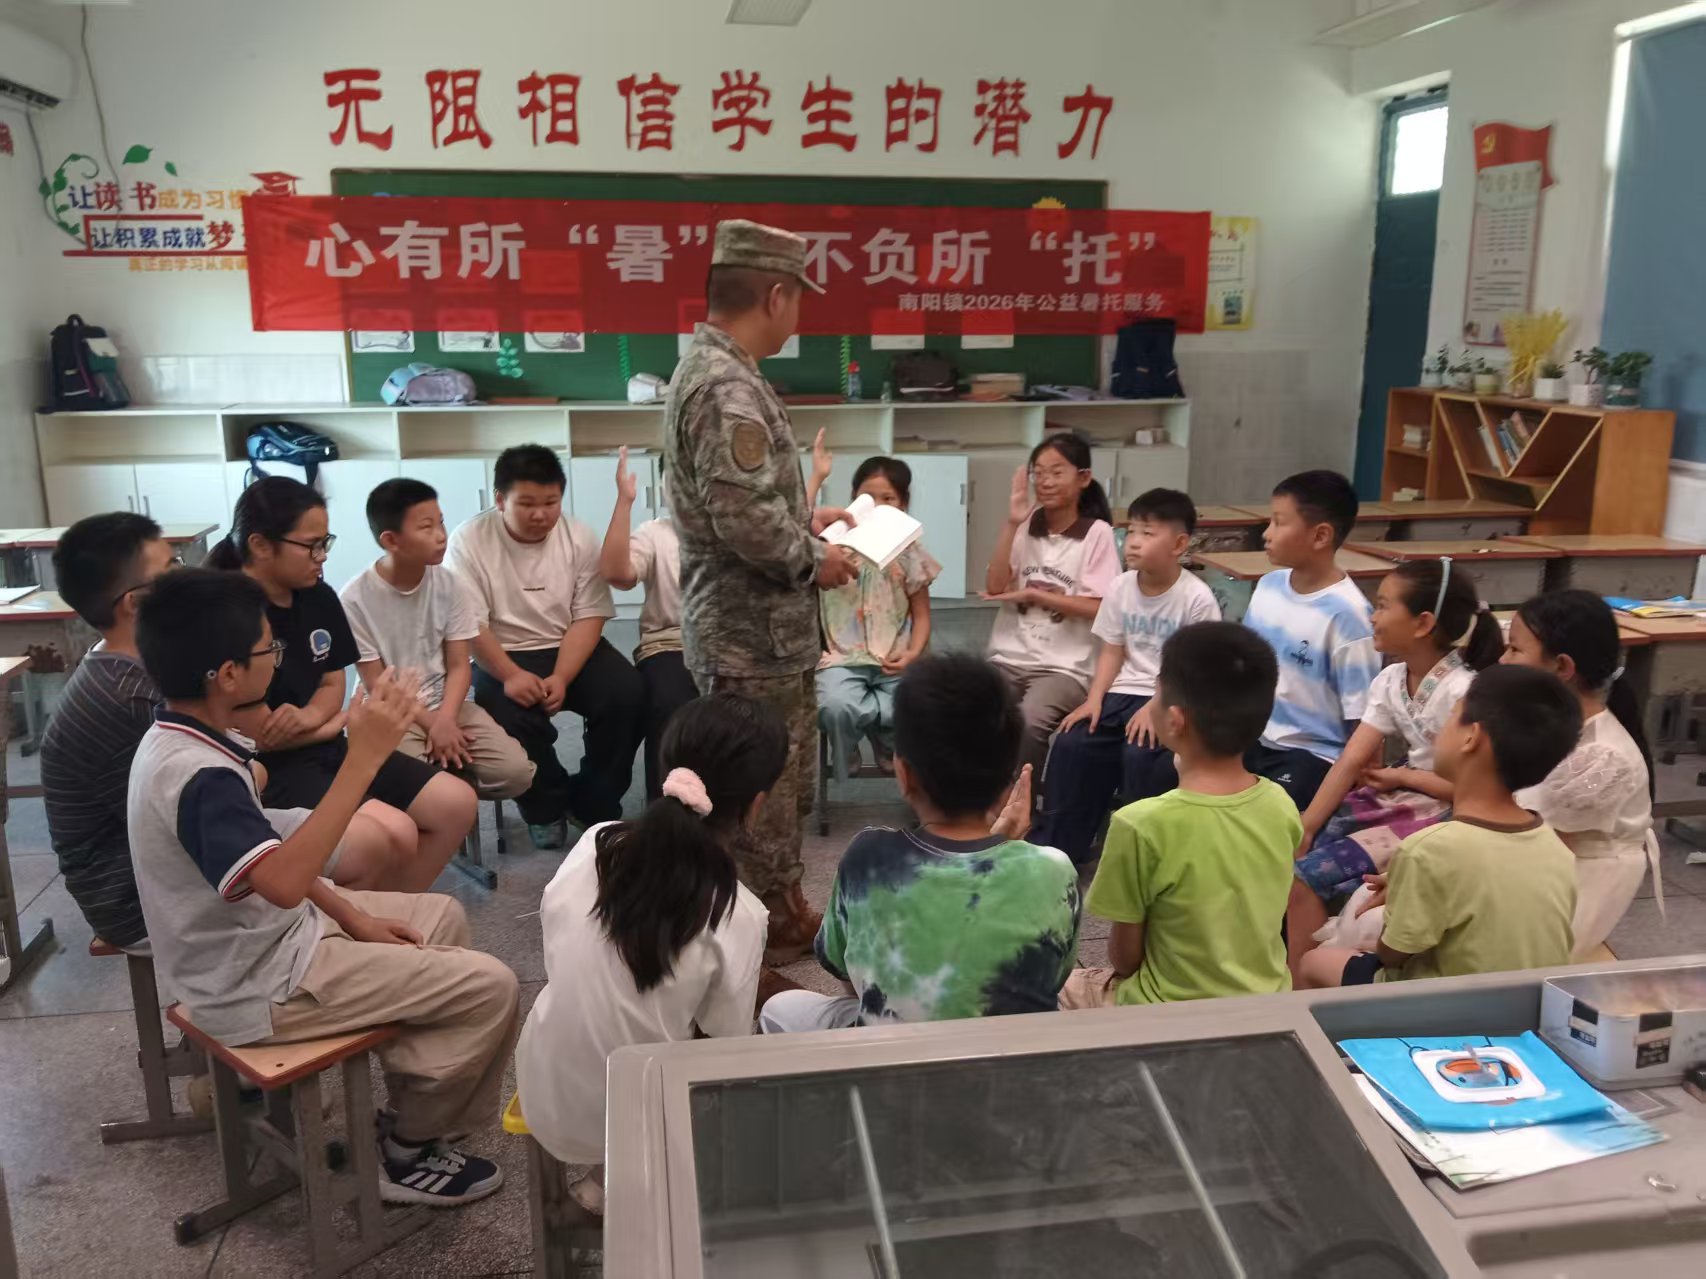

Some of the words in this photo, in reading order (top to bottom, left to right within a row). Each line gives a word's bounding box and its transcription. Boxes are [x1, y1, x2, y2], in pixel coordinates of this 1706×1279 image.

[323, 68, 1114, 160] 无限相信学生的潜力
[92, 221, 247, 250] 让积累成就梦
[897, 292, 1165, 312] 南阳镇2026年公益暑托服务
